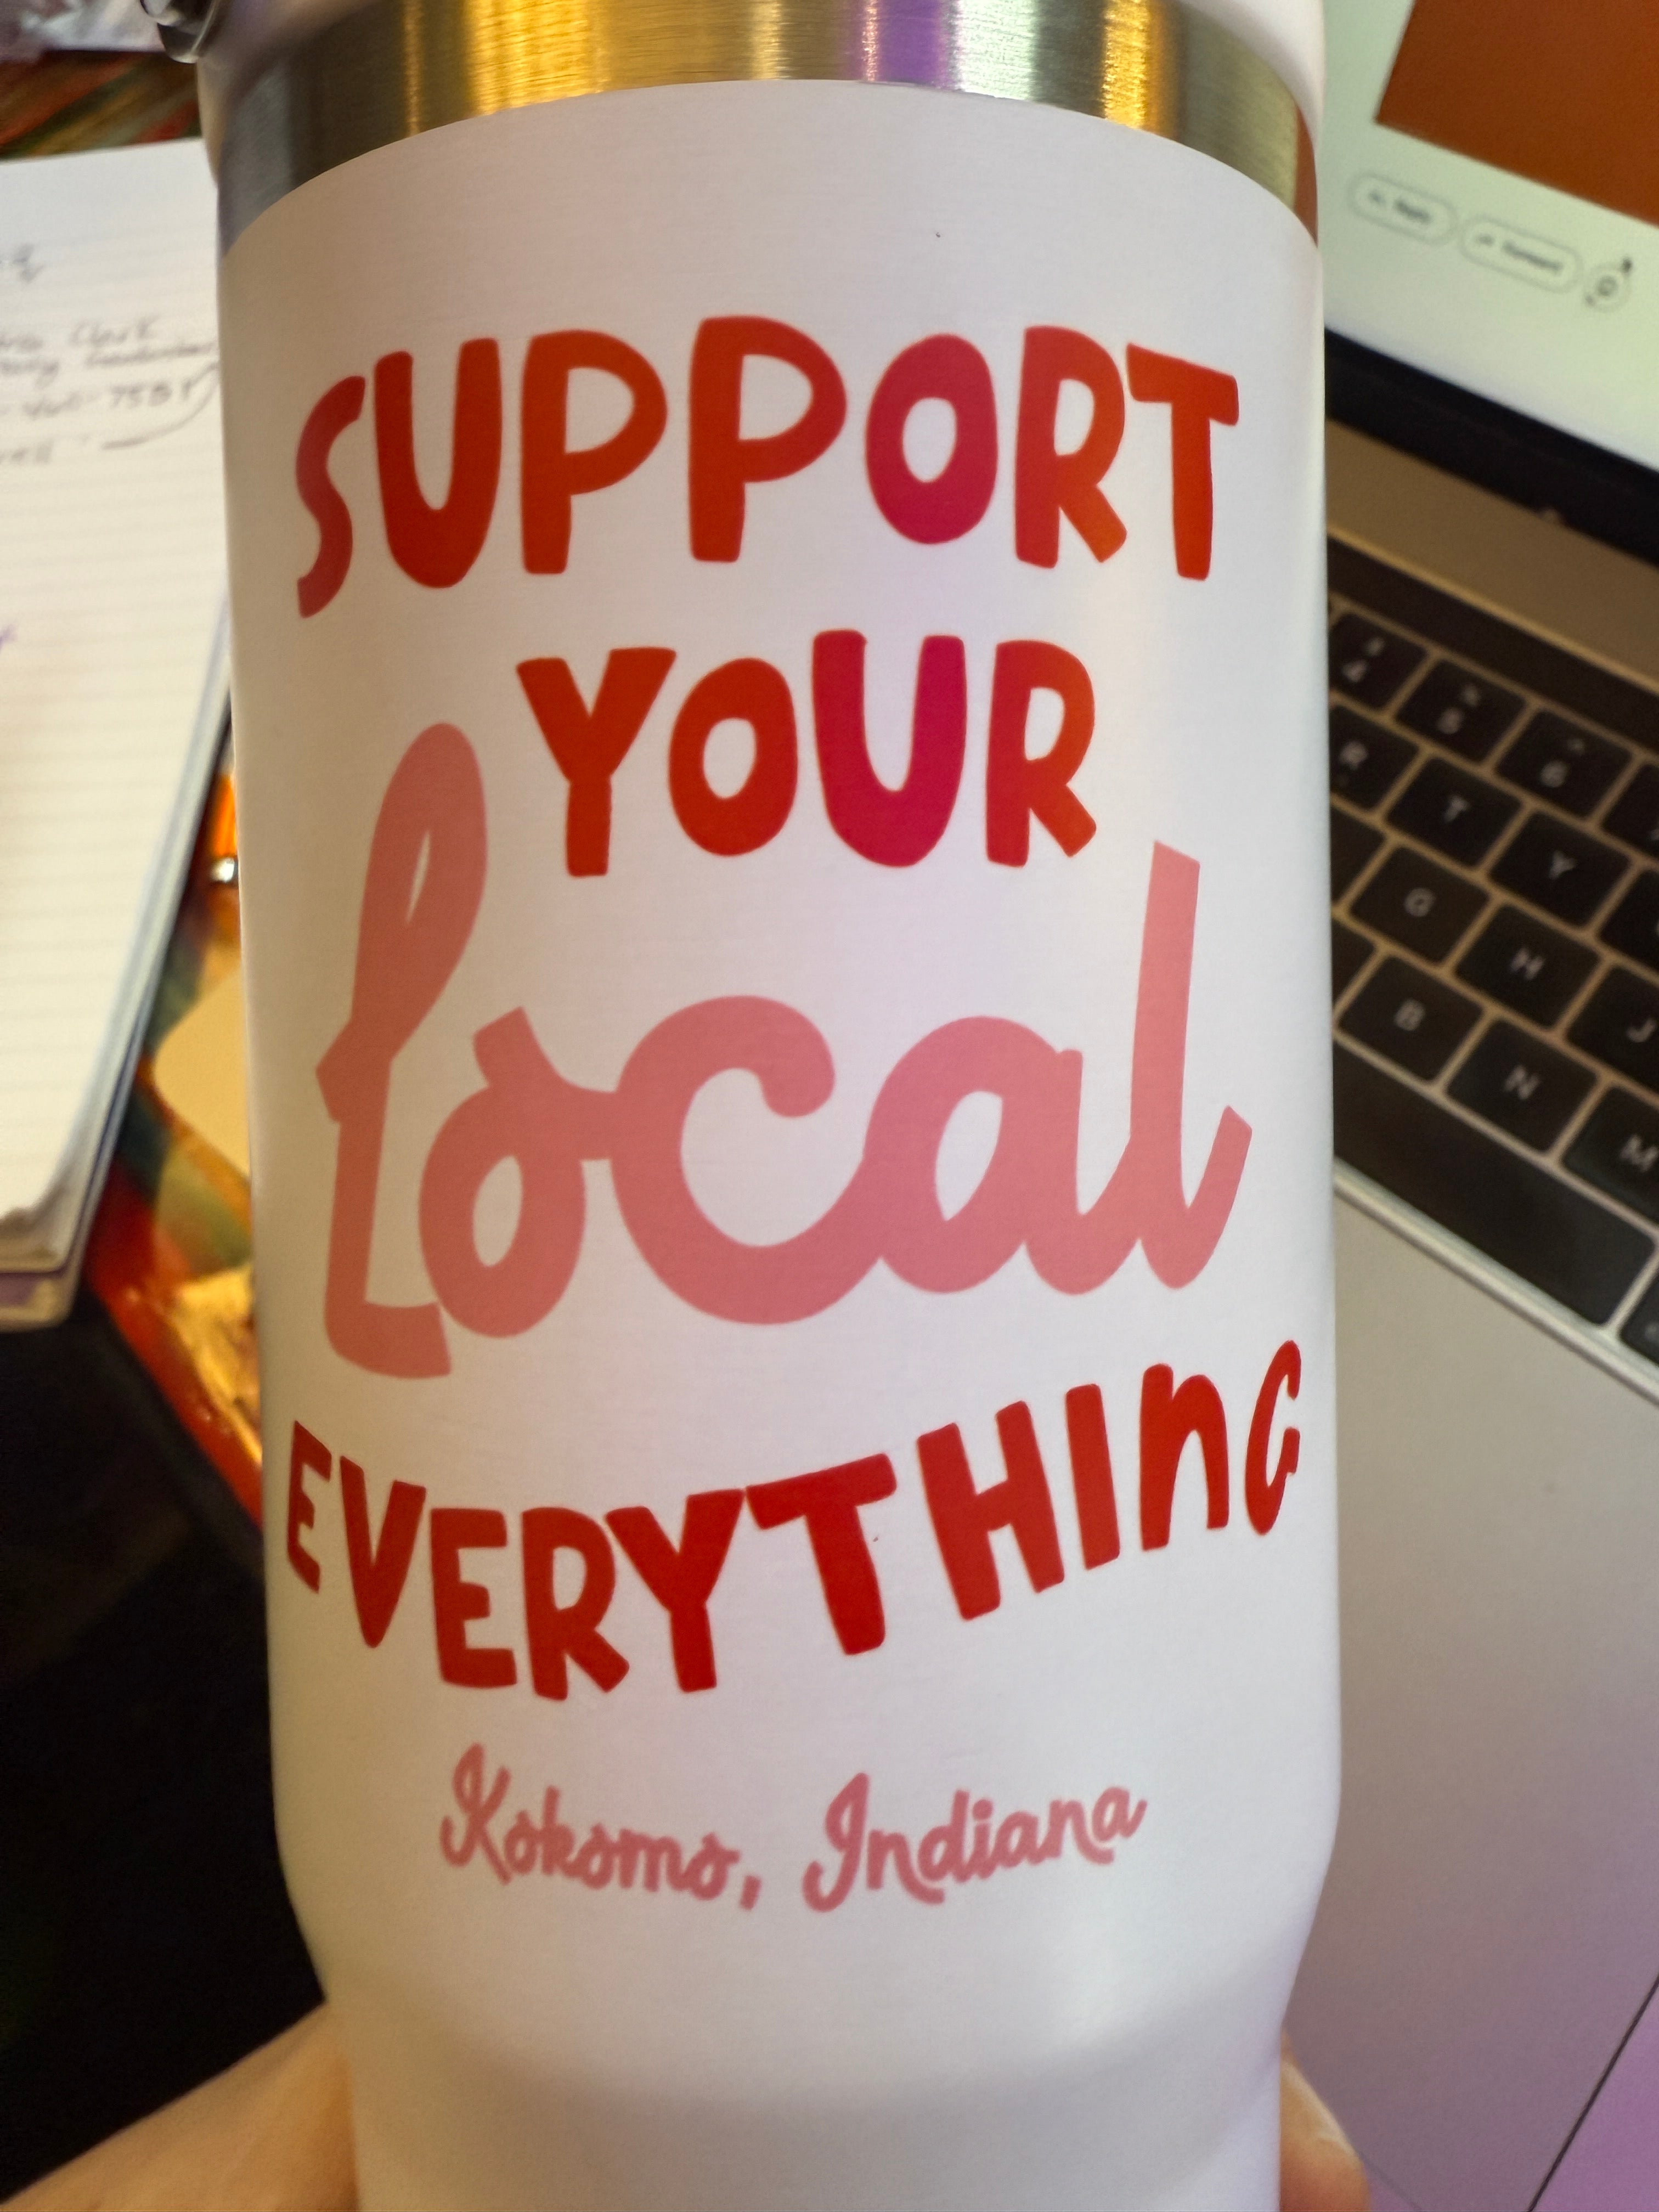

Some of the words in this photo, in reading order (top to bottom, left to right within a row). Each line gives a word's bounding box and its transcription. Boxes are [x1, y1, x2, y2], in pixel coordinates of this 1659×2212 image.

[296, 315, 1239, 617] SUPPORT
[516, 629, 1096, 878] YOUR
[1510, 947, 1545, 980] H
[1504, 1065, 1538, 1099] N
[441, 1743, 761, 1909] Kokomo,
[803, 1773, 1147, 1912] Indiana
